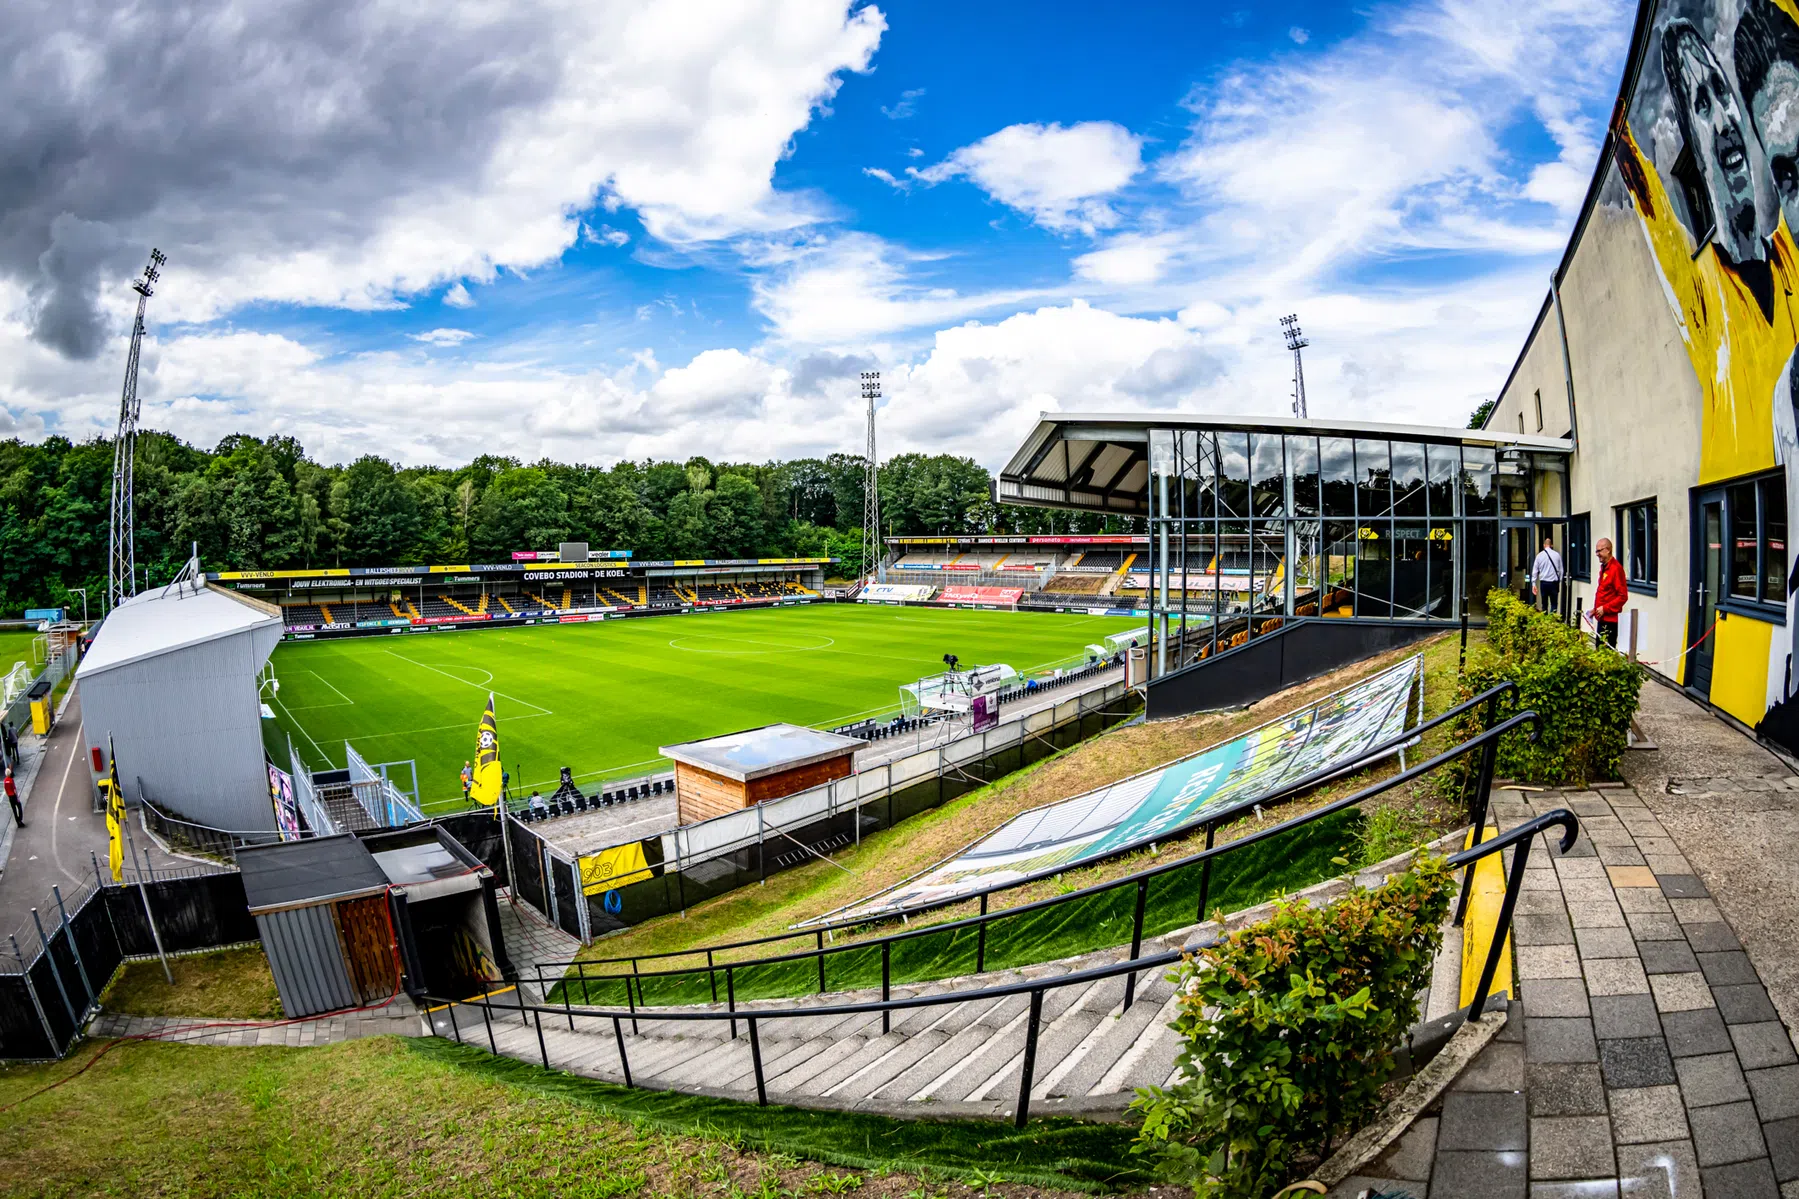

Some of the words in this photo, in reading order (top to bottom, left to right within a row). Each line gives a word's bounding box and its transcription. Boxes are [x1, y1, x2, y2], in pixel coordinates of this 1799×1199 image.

[1385, 529, 1420, 538] RSPECT
[240, 571, 275, 579] VVV-VENLO
[454, 575, 480, 583] Tummers
[523, 572, 555, 581] COVEBO
[556, 570, 588, 579] STADION
[594, 570, 605, 578] DE
[606, 569, 625, 577] KOEL
[292, 580, 310, 588] JOUW
[355, 578, 364, 586] EN
